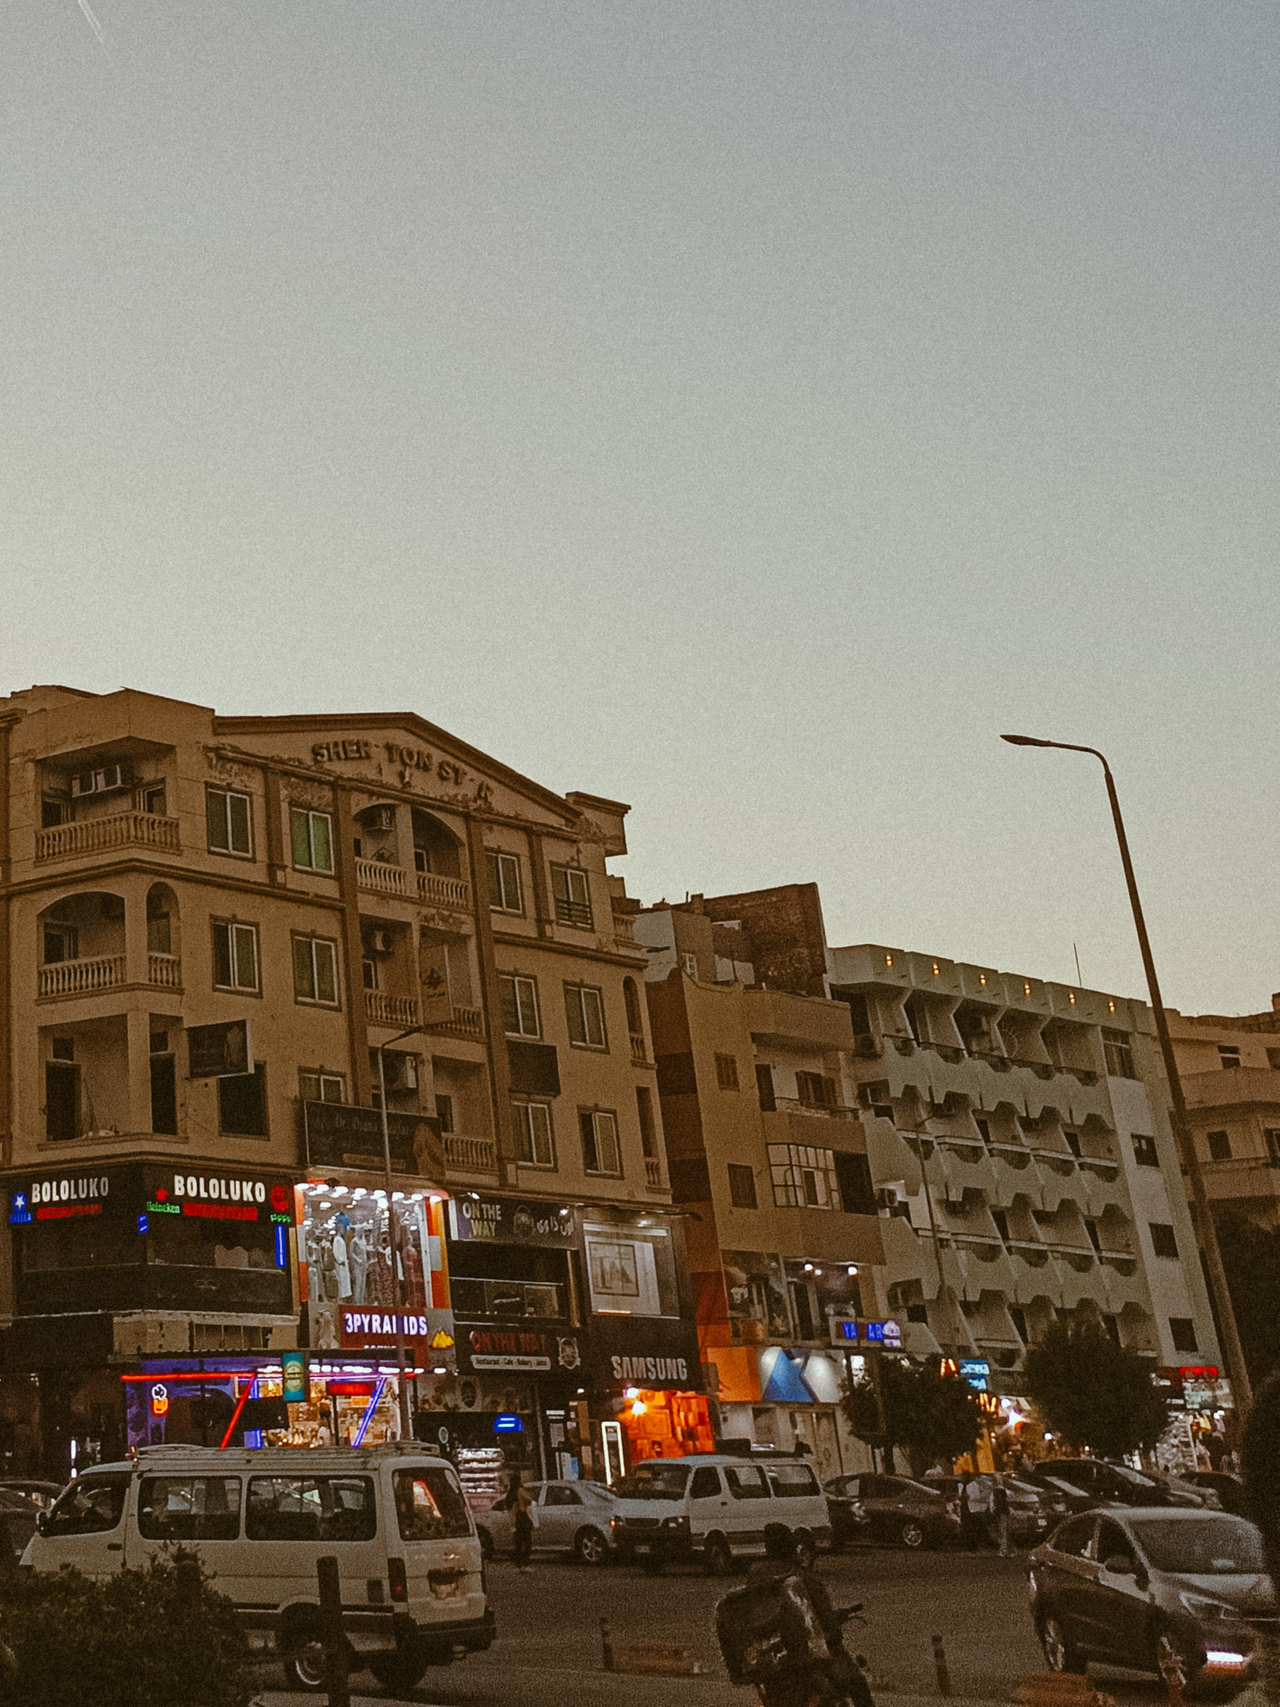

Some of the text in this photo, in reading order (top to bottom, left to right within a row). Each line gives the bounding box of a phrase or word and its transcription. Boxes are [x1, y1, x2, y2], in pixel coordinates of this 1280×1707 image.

[32, 1177, 109, 1203] BOLOLUKO
[174, 1175, 266, 1203] BOLOLUKO
[462, 1202, 501, 1220] ON THE
[470, 1219, 496, 1236] WAY
[610, 1355, 688, 1381] SAMSUNG
